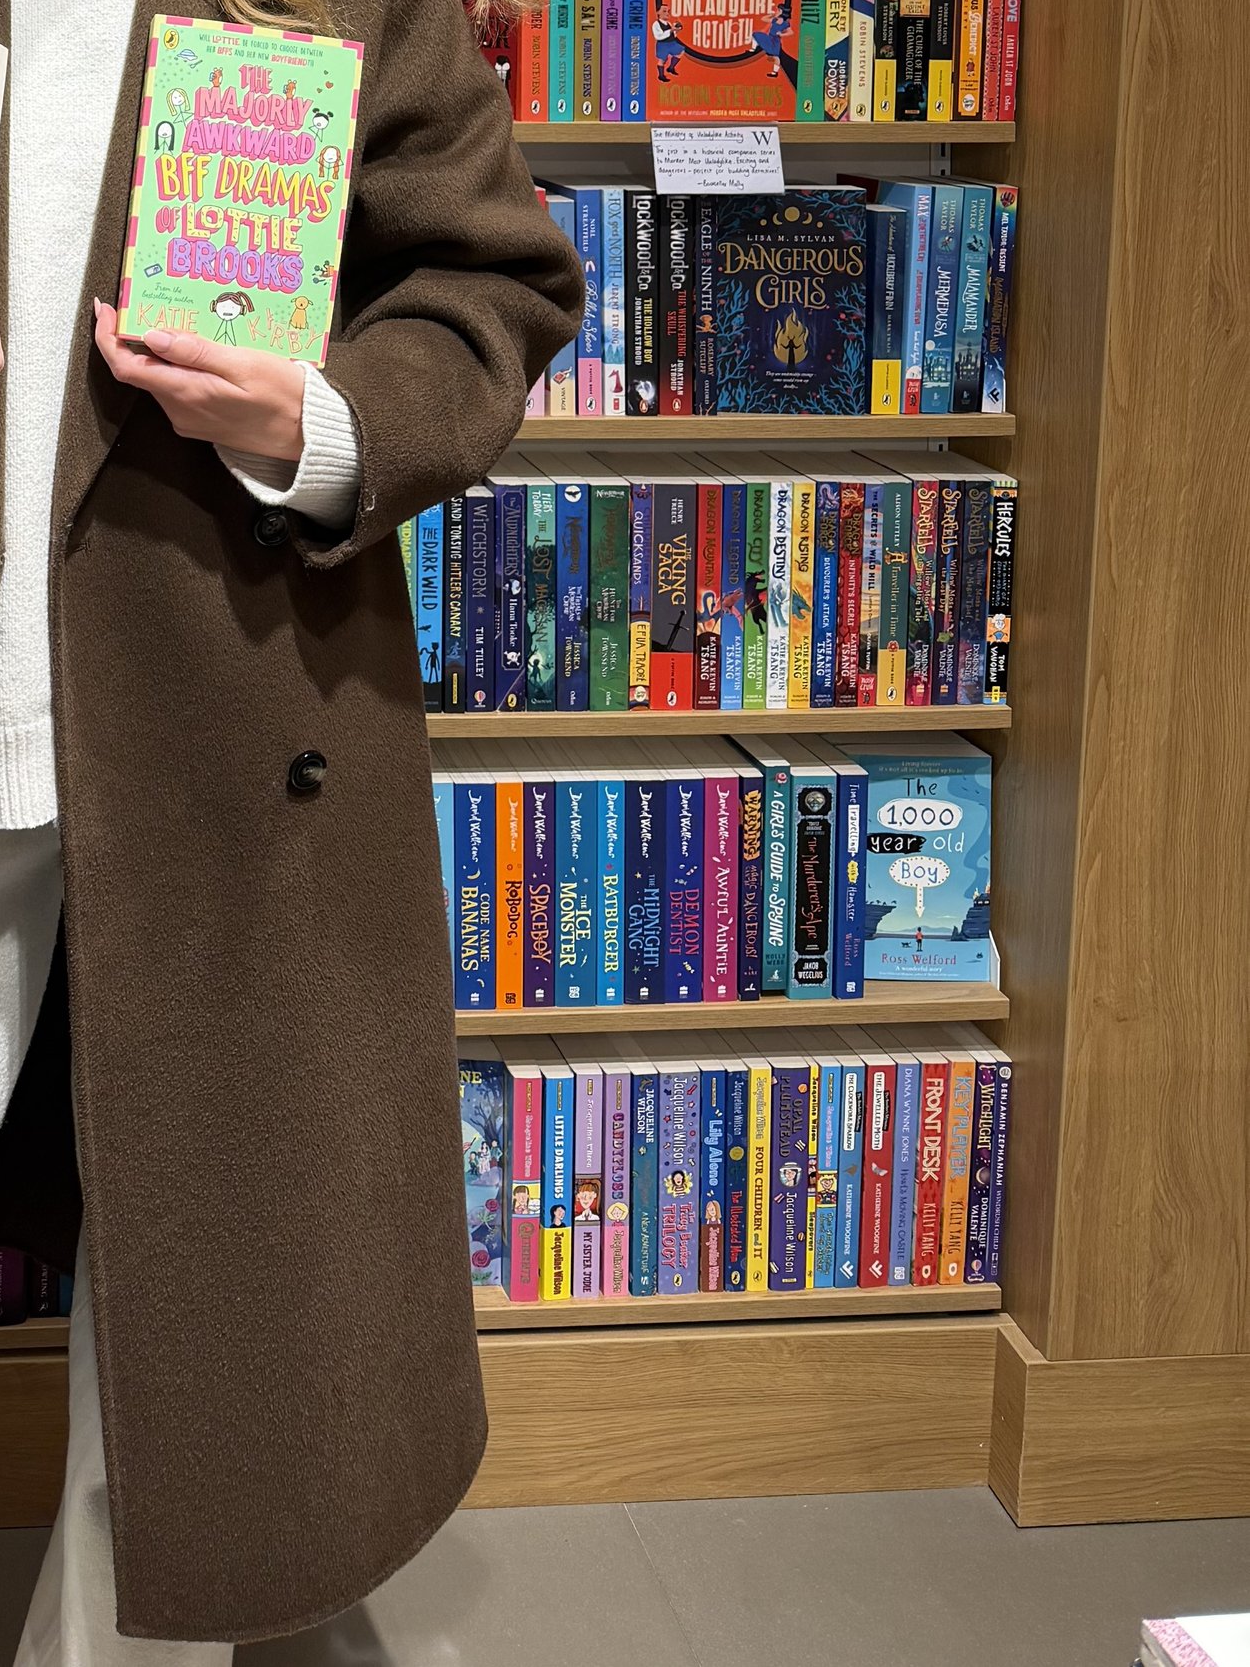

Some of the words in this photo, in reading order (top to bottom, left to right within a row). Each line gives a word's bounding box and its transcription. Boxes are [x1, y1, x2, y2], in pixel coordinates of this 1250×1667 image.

[200, 34, 211, 42] WILL
[212, 35, 240, 45] LOTTIE
[242, 39, 248, 47] BE
[251, 40, 269, 50] FORCED
[271, 42, 277, 51] TO
[280, 45, 298, 54] CHOOSE
[300, 48, 323, 57] BETWEEN
[693, 19, 754, 50] ACTIVITY
[239, 64, 273, 94] THE
[658, 85, 710, 107] ROBIN
[714, 85, 783, 108] STEVENS
[826, 60, 837, 98] DOWD
[194, 86, 313, 131] MAJORLY
[182, 119, 316, 164] AWKWARD
[665, 131, 685, 141] Ministry
[751, 131, 773, 145] W
[155, 153, 210, 202] BFF
[215, 163, 338, 222] DRAMAS
[155, 205, 181, 233] OF
[181, 202, 303, 256] LOTTIE
[747, 234, 772, 243] LISA
[776, 234, 790, 242] M.
[794, 235, 835, 243] SYLVAN
[167, 237, 304, 294] BROOKS
[718, 241, 865, 276] DANGEROUS
[753, 275, 832, 310] GIRLS
[137, 302, 200, 334] KATIE
[247, 307, 324, 354] KIRBY
[996, 501, 1011, 557] HERCULES
[657, 542, 672, 597] SAGA
[672, 533, 688, 606] VIKING
[902, 778, 938, 796] The
[886, 805, 954, 827] 1,000
[870, 836, 917, 853] year
[933, 833, 965, 853] old
[901, 861, 939, 883] Boy
[460, 886, 478, 972] BANANAS
[528, 884, 550, 966] SPACEBOY
[882, 953, 907, 964] Ross
[911, 953, 957, 965] Welford
[924, 1076, 943, 1131] FRONT
[921, 1136, 941, 1182] DESK
